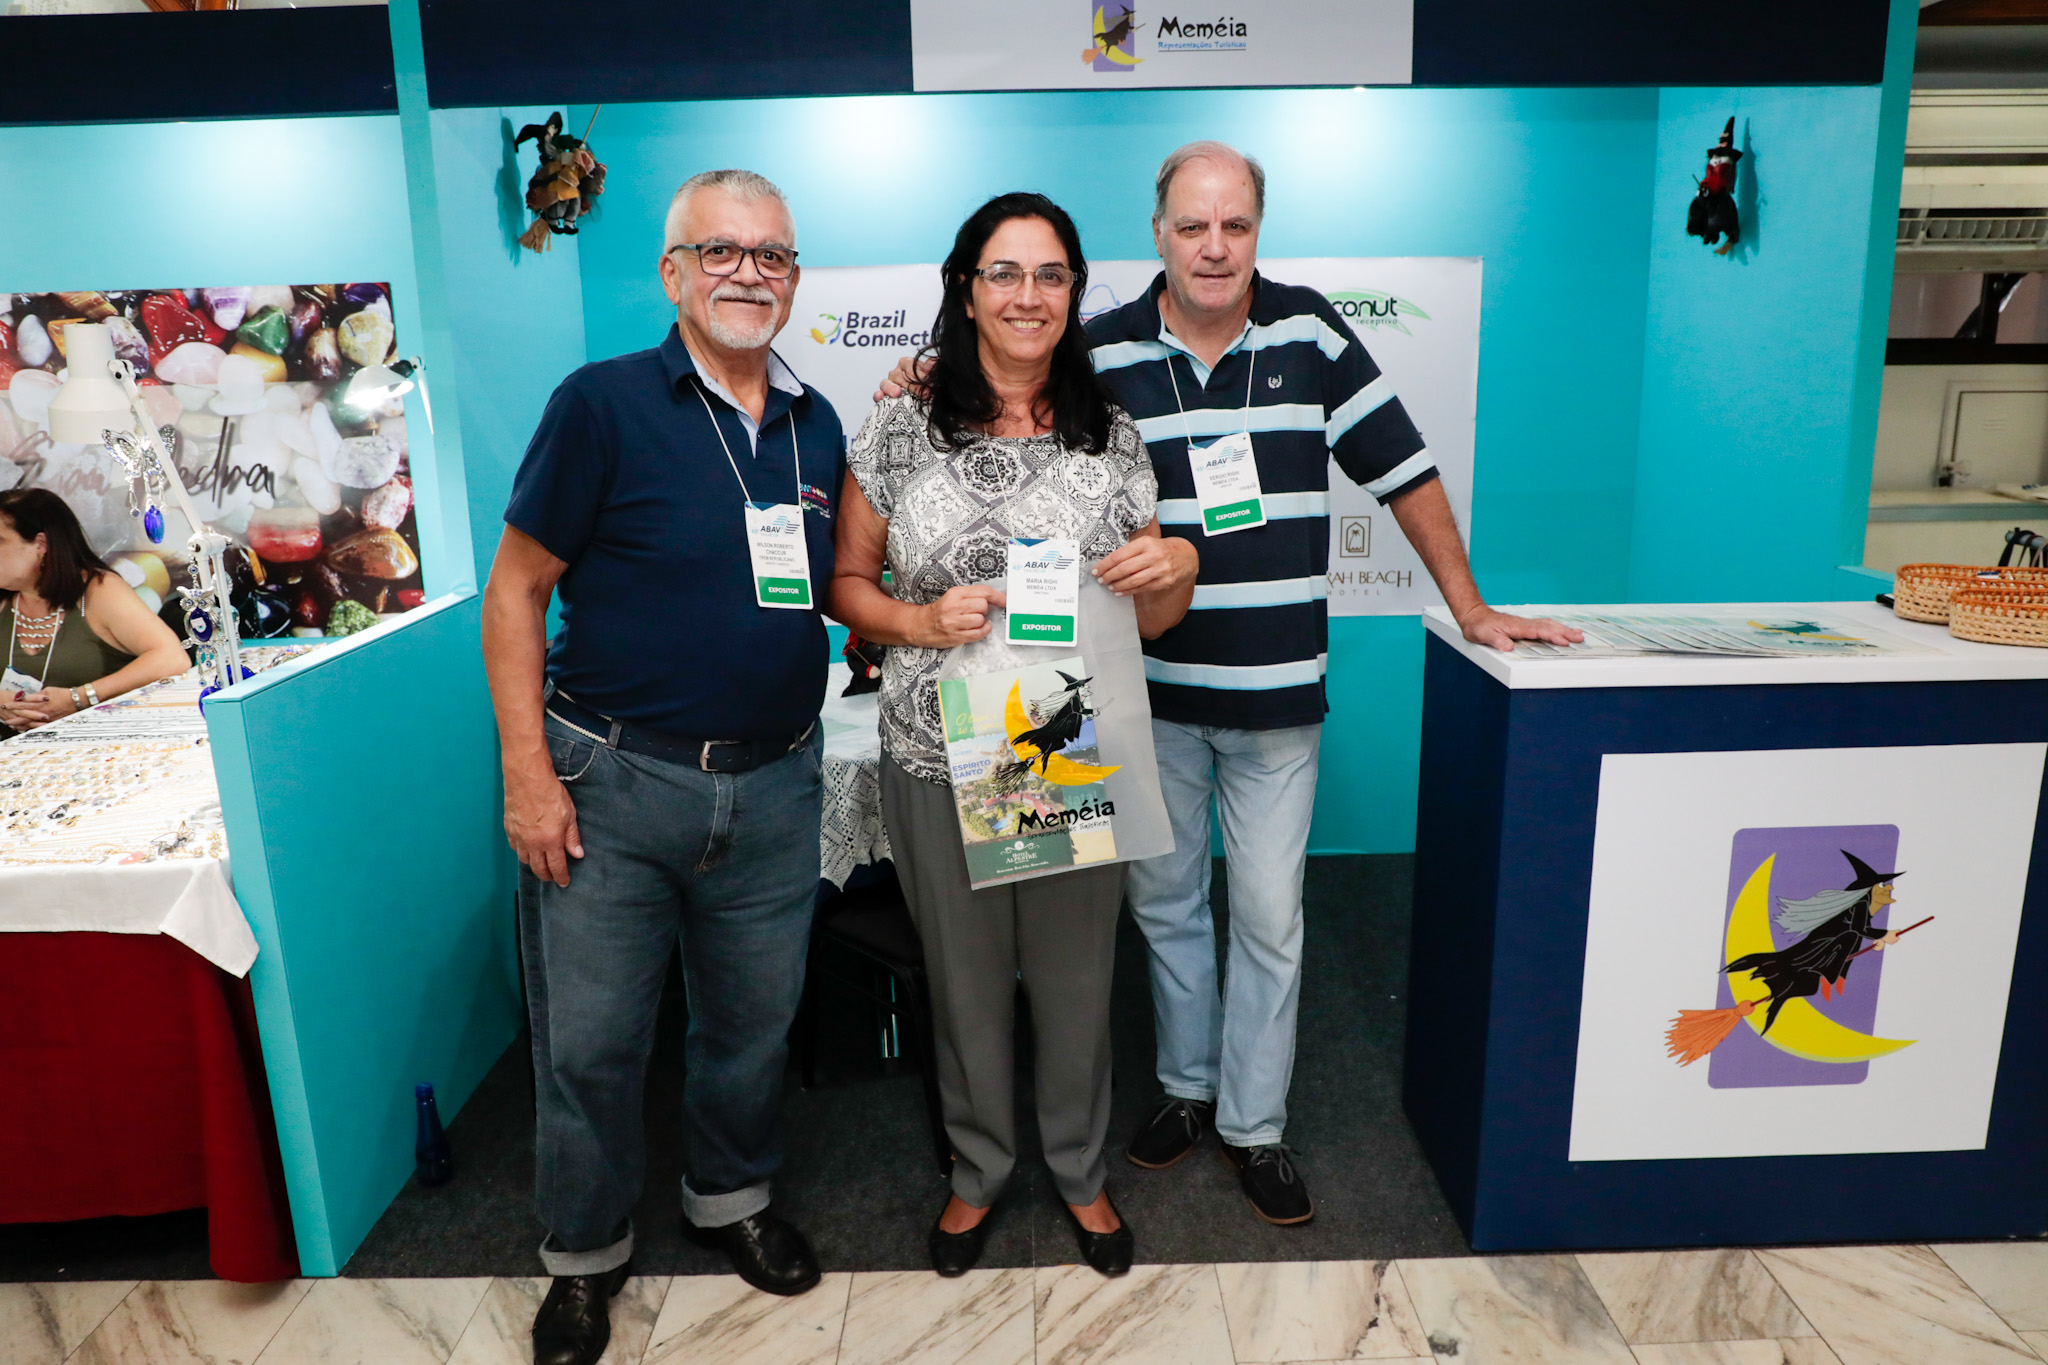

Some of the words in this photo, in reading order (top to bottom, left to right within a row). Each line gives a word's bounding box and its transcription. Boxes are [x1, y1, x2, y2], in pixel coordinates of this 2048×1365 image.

[1157, 16, 1247, 40] Meméia
[846, 310, 906, 329] Brazil
[1356, 318, 1398, 327] receptivo
[842, 329, 930, 347] Connect
[1206, 458, 1228, 467] ABAV
[1215, 509, 1251, 521] EXPOSITOR
[760, 525, 781, 533] ABAV
[1024, 561, 1050, 569] ABAV
[1359, 570, 1412, 587] BEACH
[768, 586, 800, 594] EXPOSITOR
[952, 759, 991, 772] ESPÍRITO
[953, 768, 983, 779] SANTO
[1017, 798, 1115, 834] Meméia
